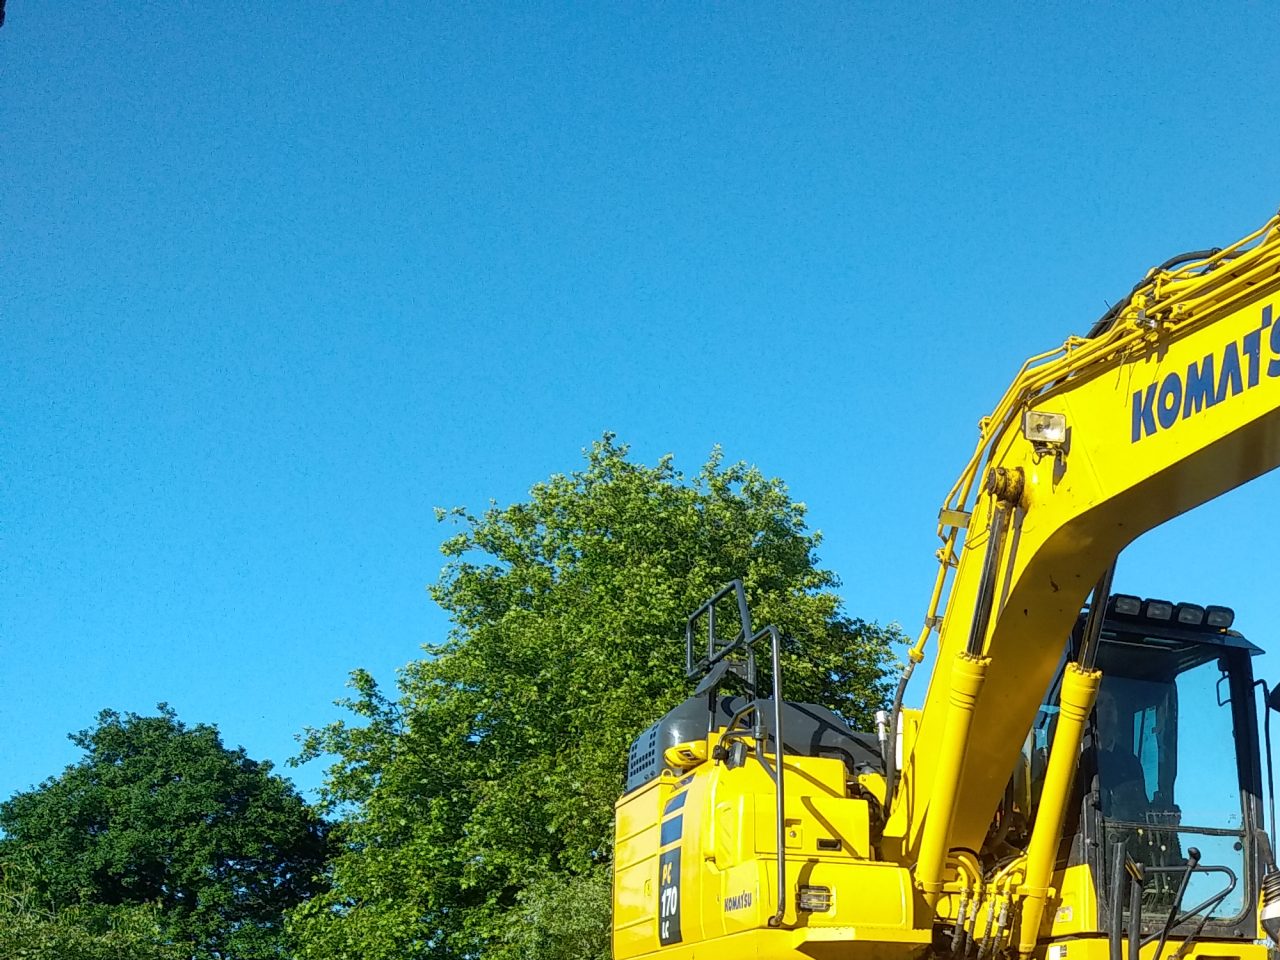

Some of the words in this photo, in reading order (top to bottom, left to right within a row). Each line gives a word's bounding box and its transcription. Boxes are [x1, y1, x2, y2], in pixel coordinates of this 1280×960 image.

[662, 862, 672, 886] PC
[661, 886, 678, 918] 170
[724, 890, 752, 912] KOMATSU
[662, 920, 670, 939] LC
